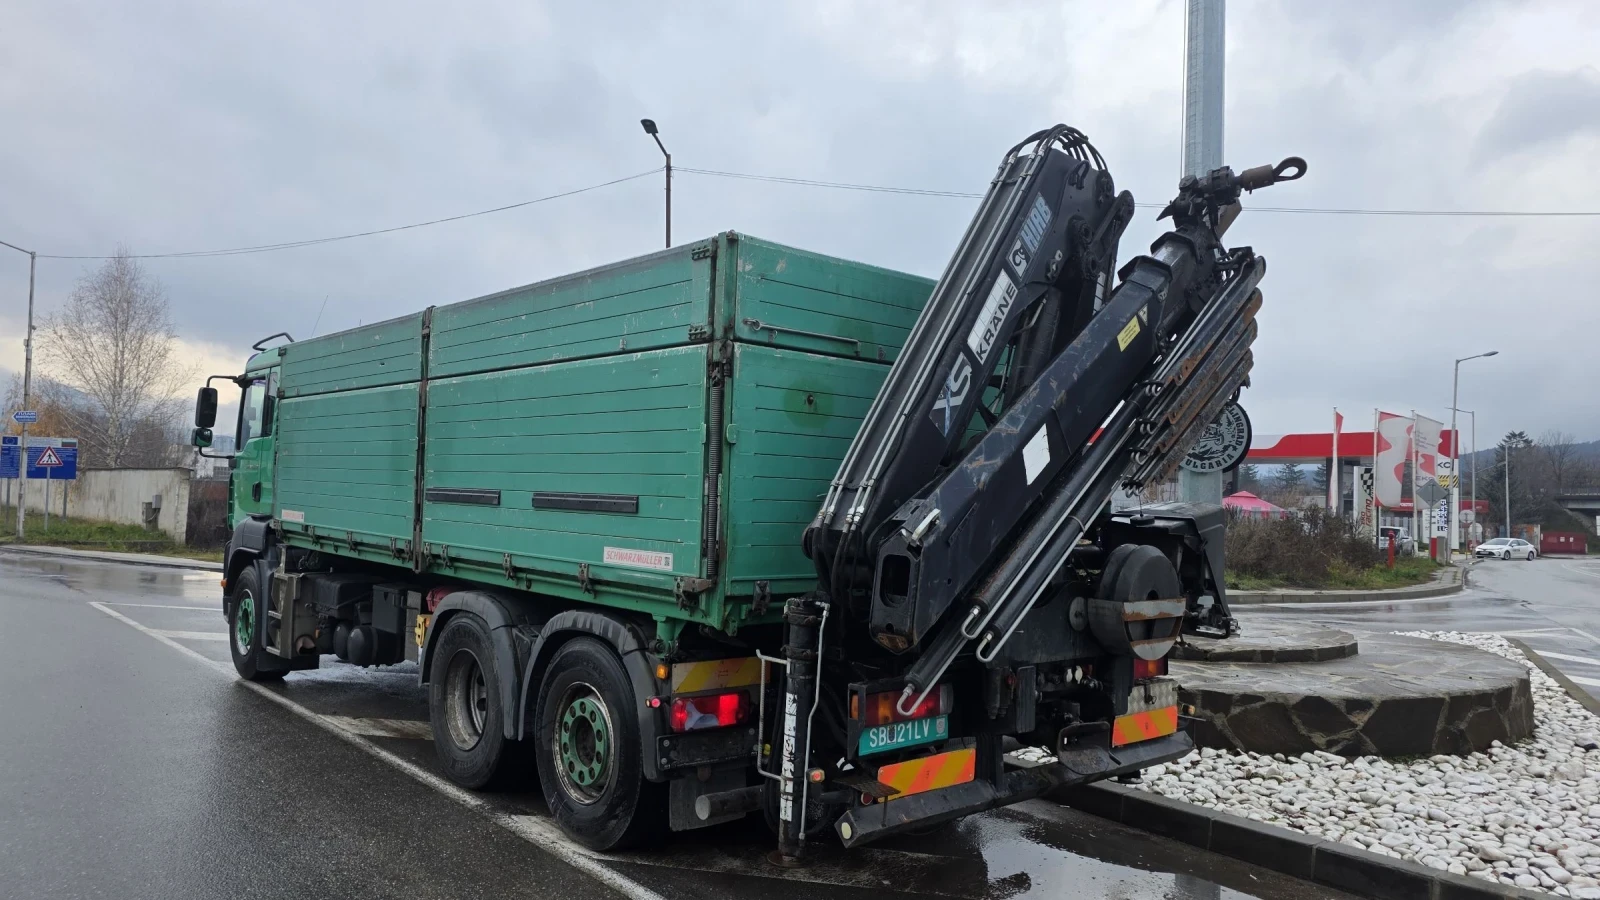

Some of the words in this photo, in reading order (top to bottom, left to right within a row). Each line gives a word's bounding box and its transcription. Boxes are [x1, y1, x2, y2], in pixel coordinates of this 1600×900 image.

[1021, 197, 1051, 253] HIAB
[976, 283, 1016, 360] KRÄNE
[932, 352, 972, 437] XS
[1185, 453, 1235, 470] ULGARIA
